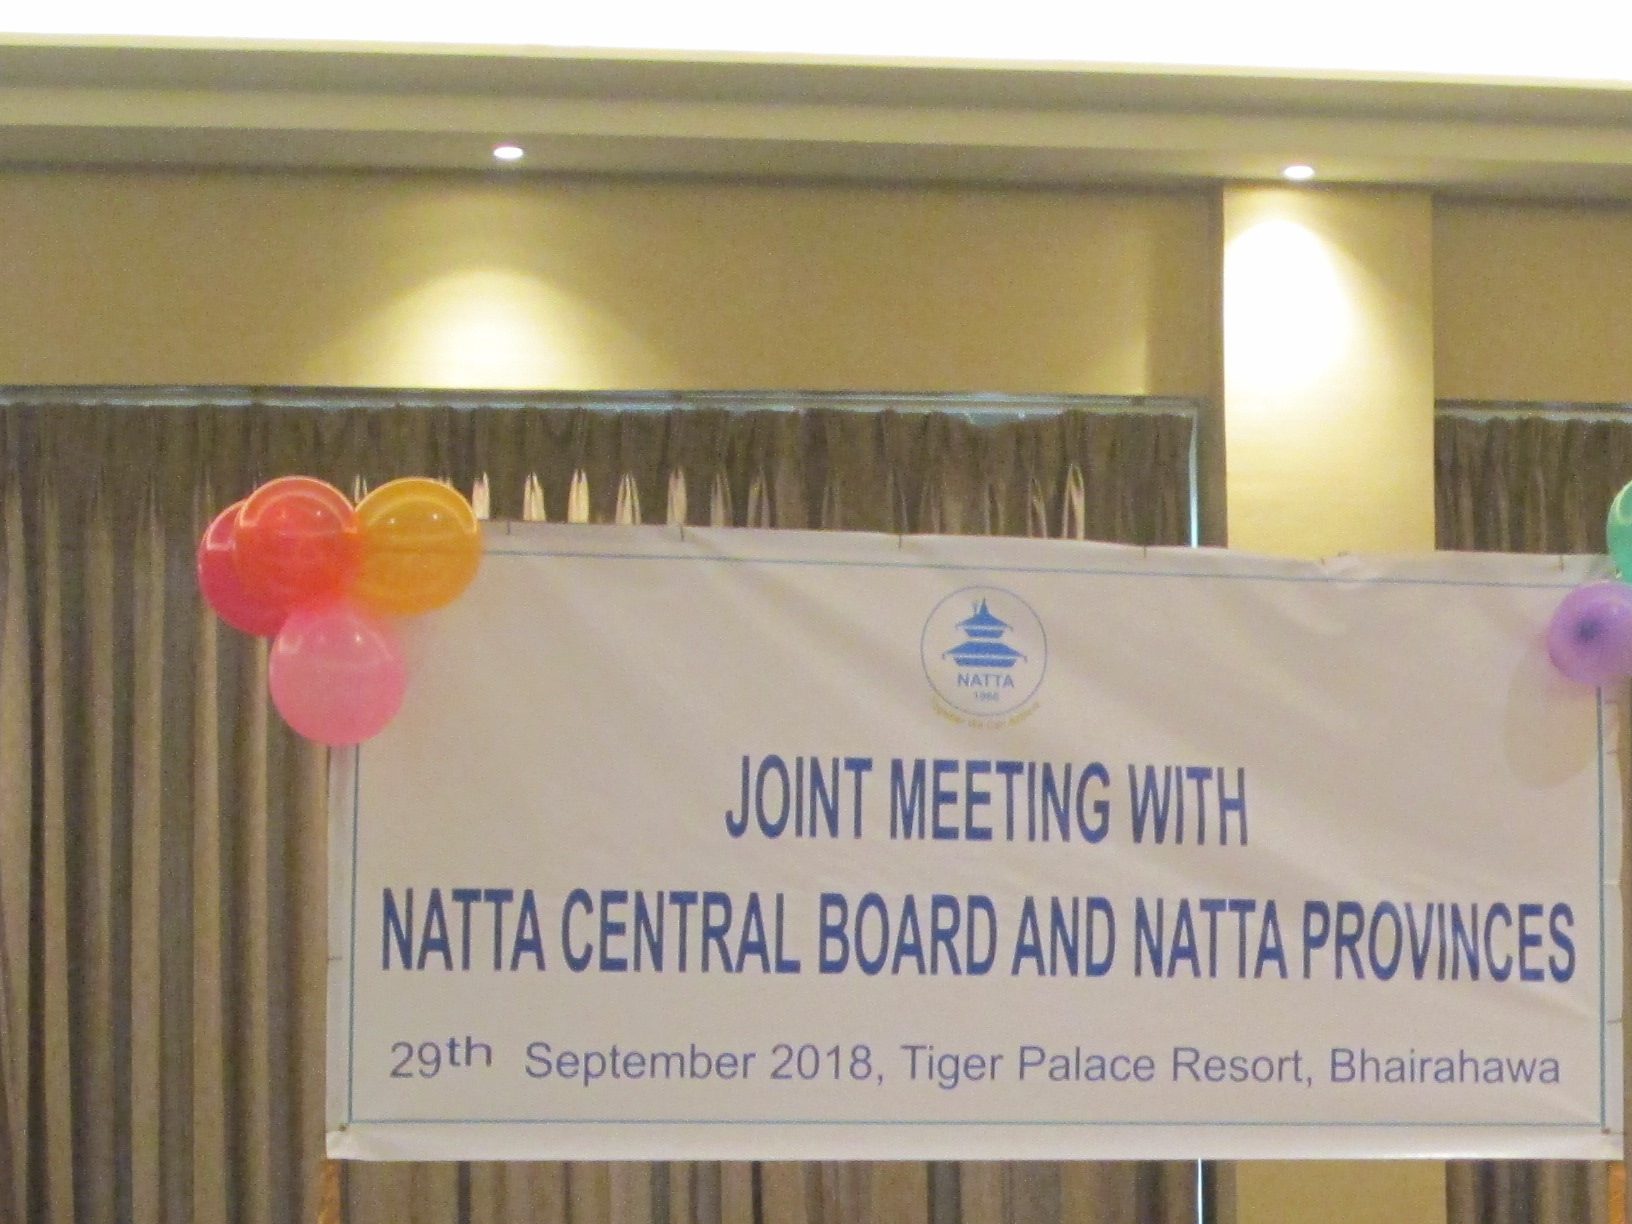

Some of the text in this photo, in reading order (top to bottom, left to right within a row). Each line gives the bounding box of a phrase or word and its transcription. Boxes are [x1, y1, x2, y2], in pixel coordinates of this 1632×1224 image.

[957, 673, 1015, 688] NATTA
[725, 754, 1249, 846] JOINT MEETING WITH
[381, 886, 1577, 984] NATTA CENTRAL BOARD AND NATTA PROVINCES
[389, 1035, 1561, 1090] 29th September 2018, Tiger Palace Resort, Bhairahawa
